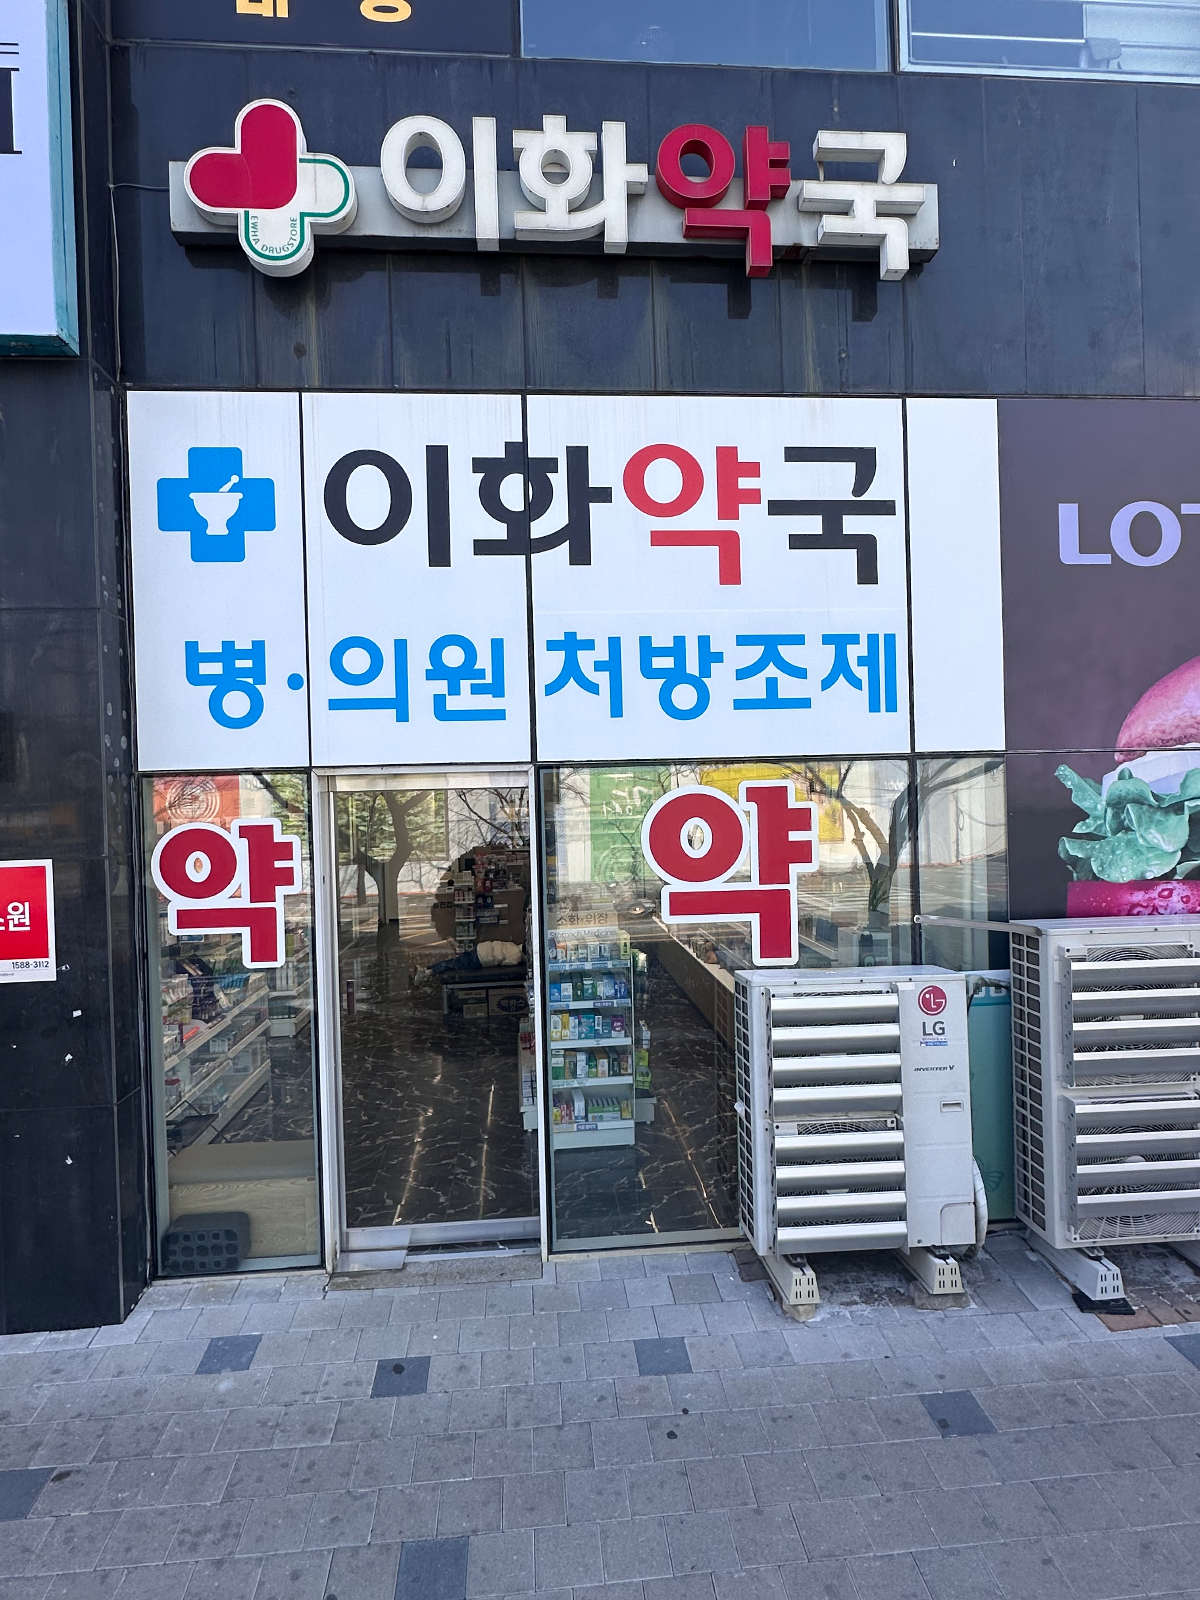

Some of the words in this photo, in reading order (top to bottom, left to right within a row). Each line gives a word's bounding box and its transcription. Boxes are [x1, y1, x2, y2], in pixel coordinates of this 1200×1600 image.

[250, 215, 260, 246] EWHA
[260, 216, 298, 255] DRUGSTORE
[380, 114, 926, 281] 이화약국
[323, 441, 897, 586] 이화약국
[544, 631, 898, 721] 처방조제
[0, 901, 31, 932] 원
[156, 821, 298, 965] 약
[646, 783, 815, 962] 약
[12, 960, 50, 970] 1588-3112
[922, 1020, 946, 1036] LG
